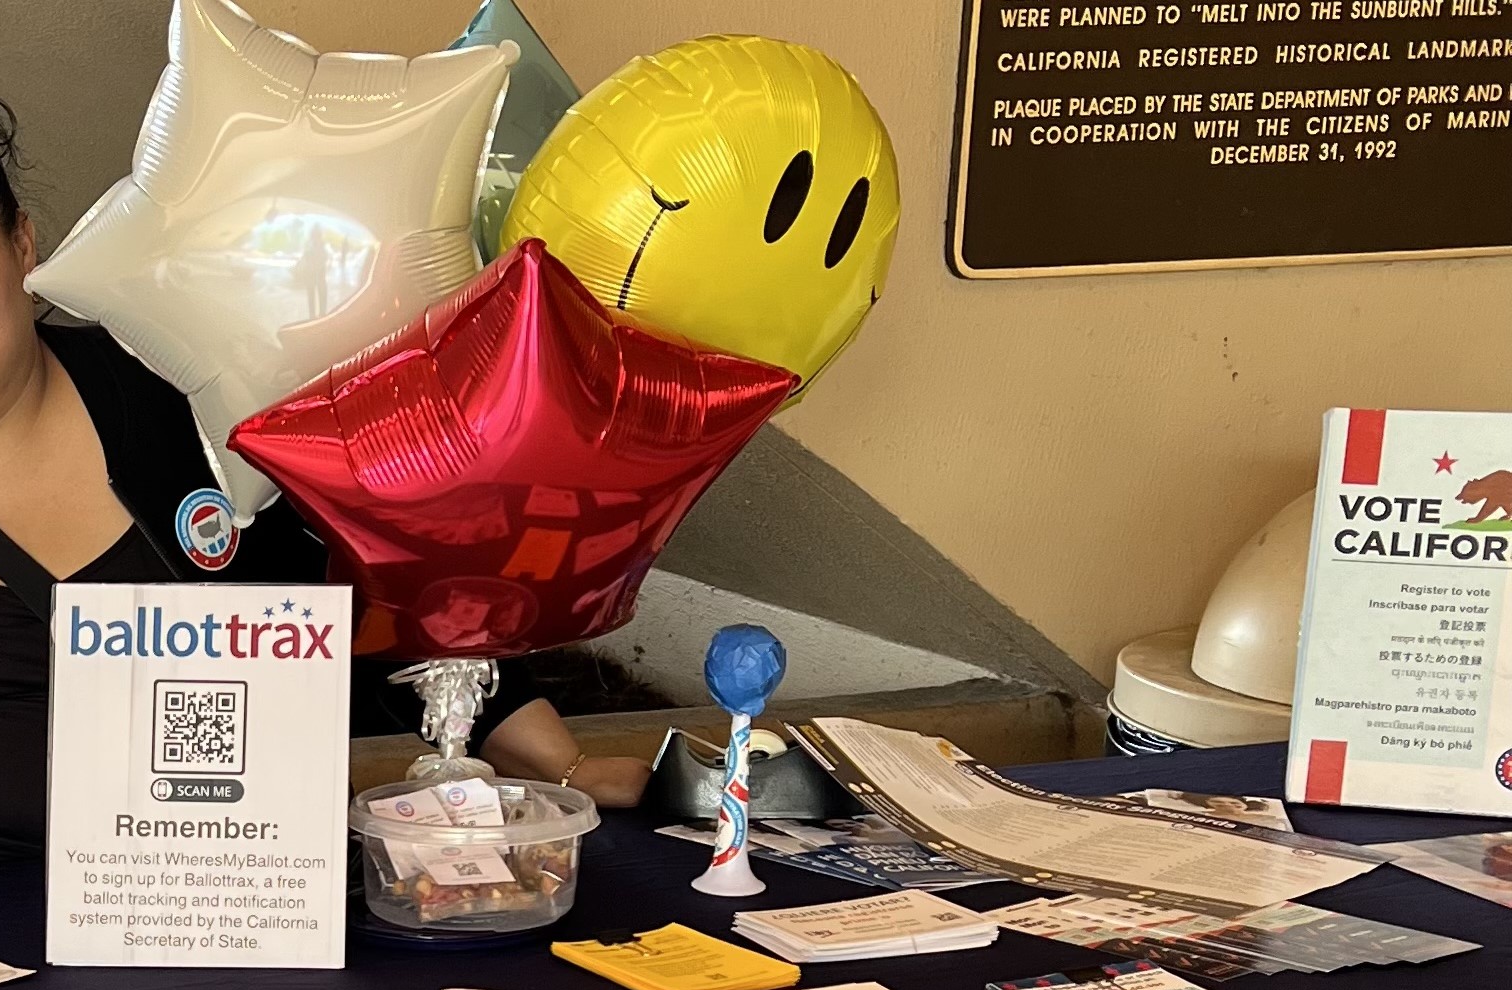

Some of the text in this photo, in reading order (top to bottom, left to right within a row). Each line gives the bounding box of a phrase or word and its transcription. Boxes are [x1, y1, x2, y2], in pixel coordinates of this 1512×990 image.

[1001, 8, 1050, 27] WERE
[1059, 6, 1147, 26] PLANNED
[1157, 5, 1181, 24] TO
[1256, 2, 1300, 22] INTO
[1311, 1, 1342, 20] THE
[1351, 0, 1442, 19] SUNBURNT
[997, 50, 1121, 72] CALIFORNIA
[1138, 46, 1258, 68] REGISTERED
[1275, 42, 1391, 64] HISTORICAL
[994, 98, 1062, 119] PLAQUE
[1068, 96, 1137, 117] PLACED
[1144, 95, 1167, 114] BY
[1172, 93, 1203, 113] THE
[1209, 92, 1254, 112] STATE
[1261, 88, 1371, 110] DEPARTMENT
[1376, 87, 1401, 106] OF
[1407, 85, 1459, 105] PARKS
[1464, 84, 1503, 103] AND
[991, 110, 1511, 146] IN COOPERATION WITH THE CITIZENS OF MARIN
[1210, 140, 1397, 164] DECEMBER 31, 1992
[1339, 494, 1443, 524] VOTE
[1400, 583, 1491, 597] Register to vote
[1431, 604, 1456, 613] para
[1459, 605, 1489, 614] votar
[70, 605, 334, 660] ballottrax
[1314, 697, 1477, 717] Magparehistro para makaboto
[177, 784, 232, 798] SCAN ME
[974, 763, 1239, 829] Election Security Safeguards
[115, 814, 279, 840] Remember:
[66, 850, 326, 871] You can visit WheresMyBallot.com
[84, 872, 307, 890] to sign up for Ballottrax, a free
[83, 892, 306, 910] ballot tracking and notification
[69, 912, 318, 931] system provided by the California
[123, 932, 262, 949] Secretary of State.
